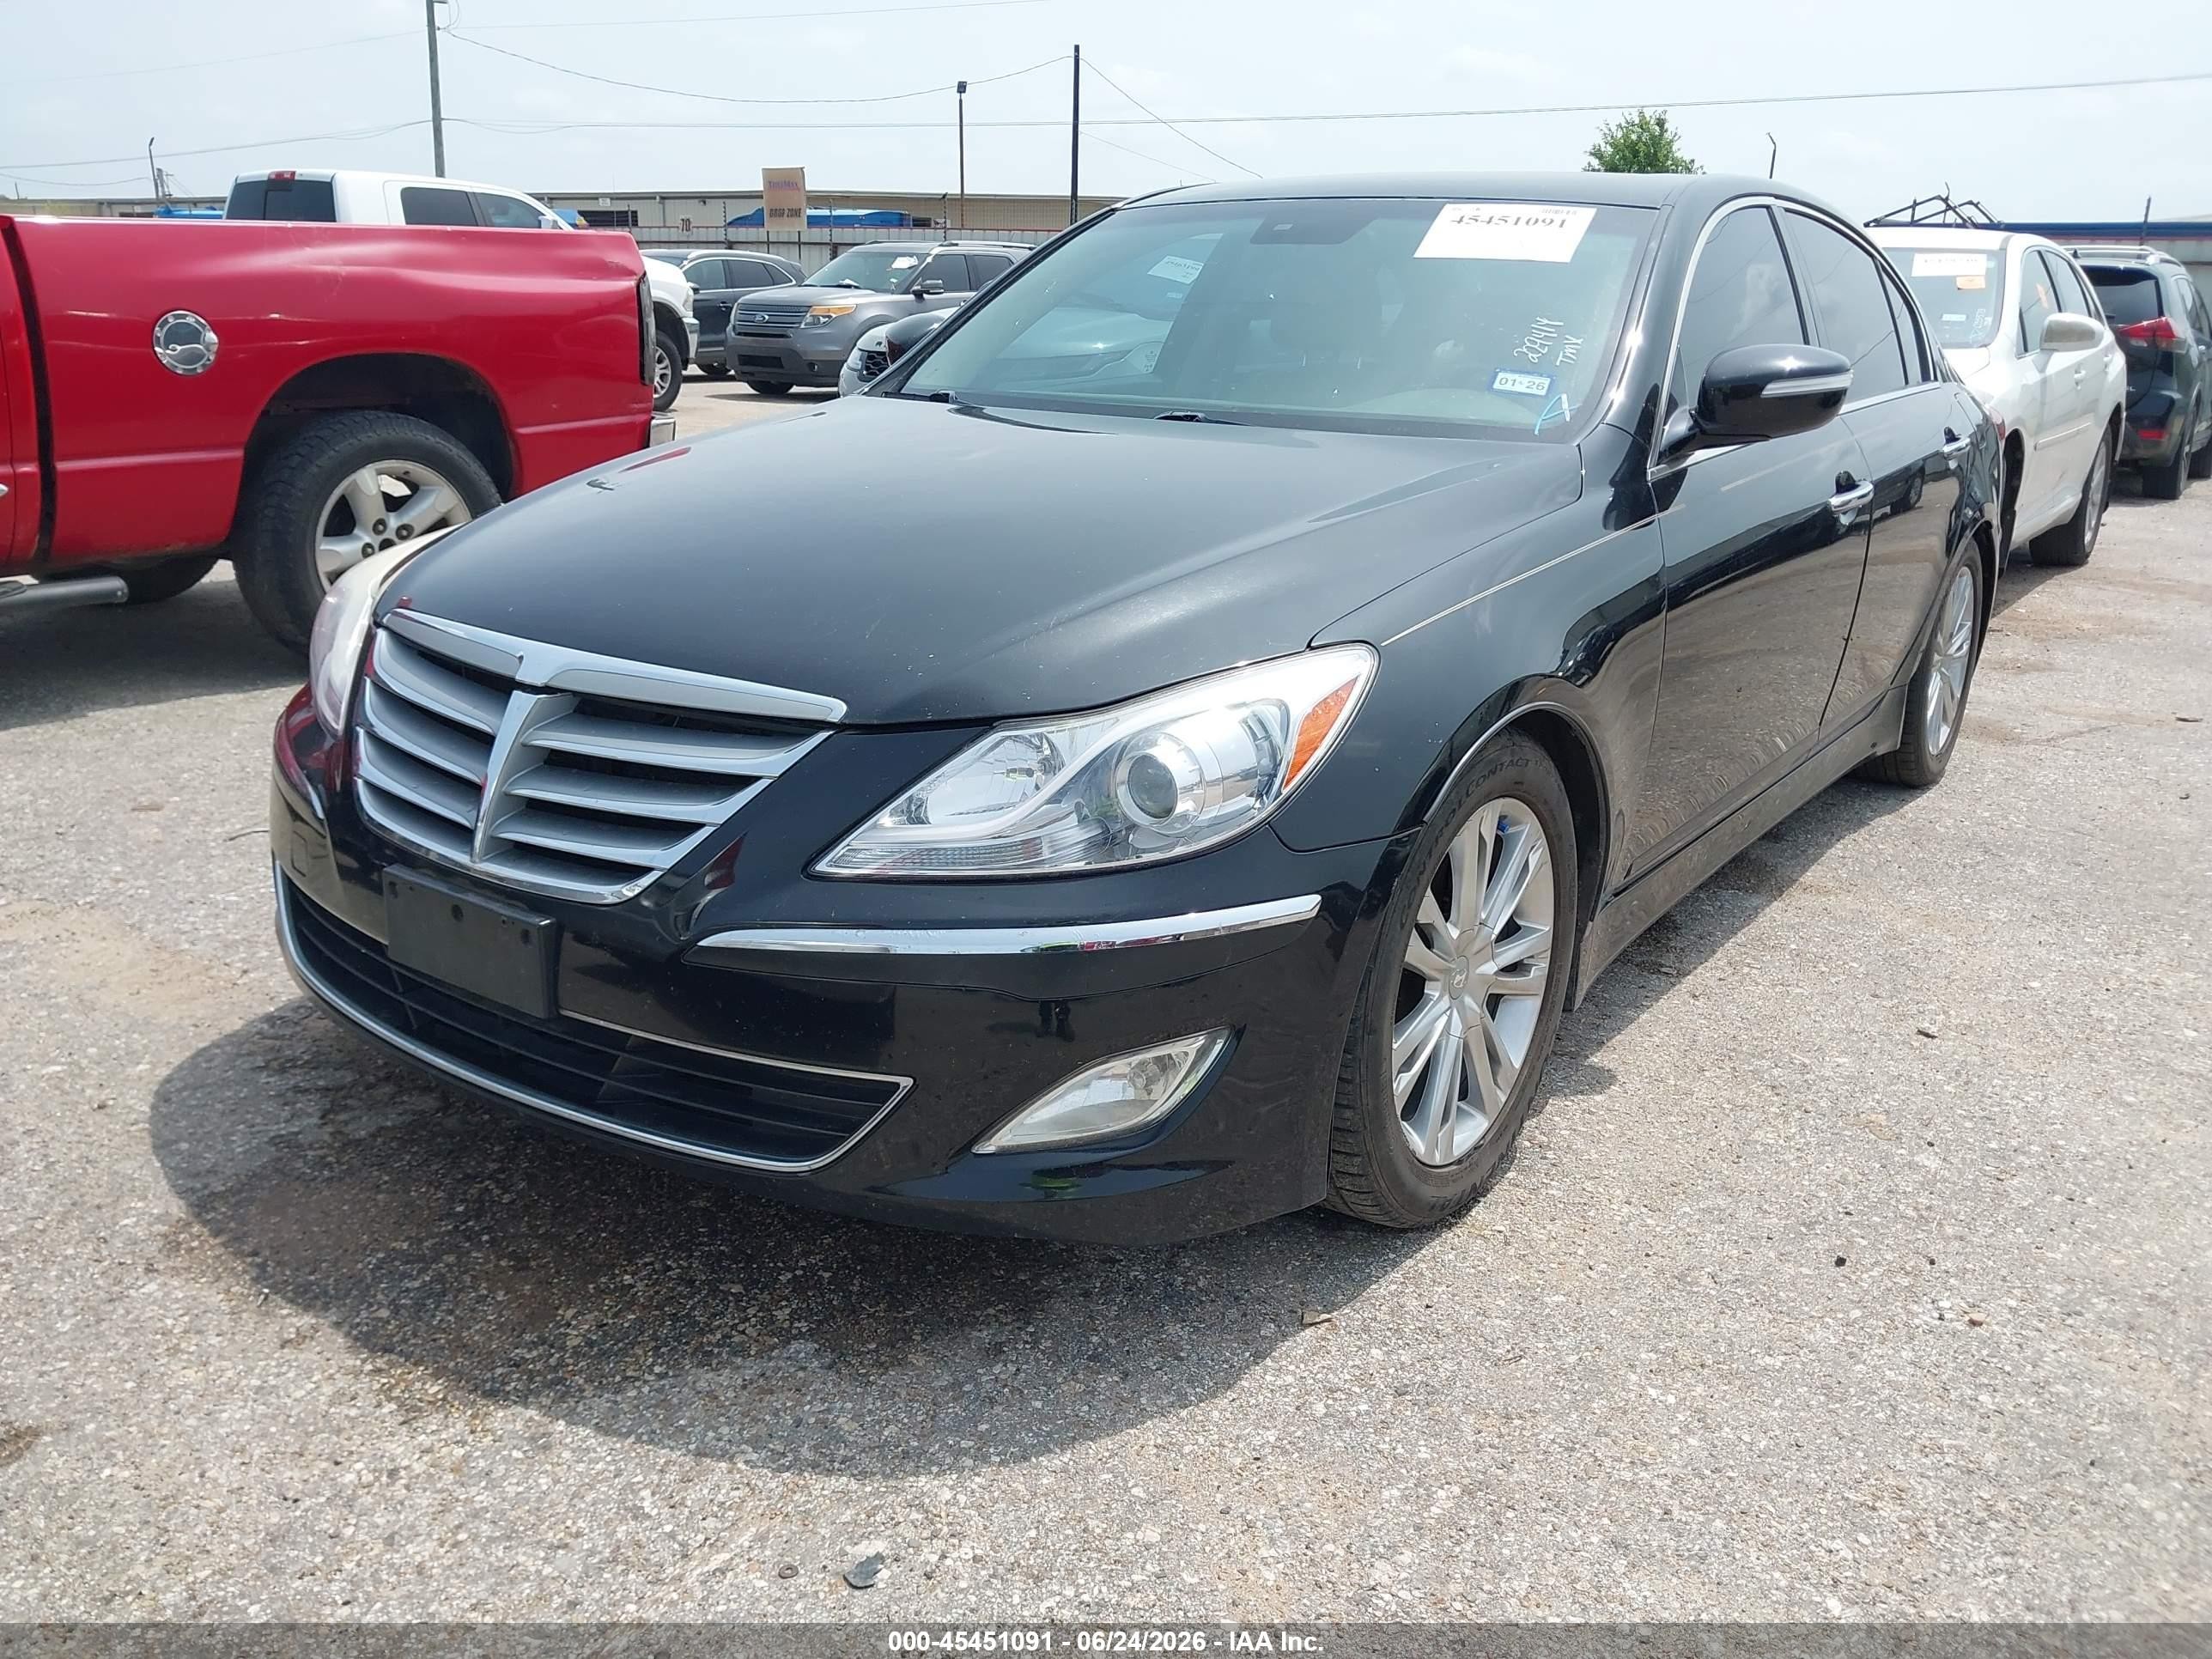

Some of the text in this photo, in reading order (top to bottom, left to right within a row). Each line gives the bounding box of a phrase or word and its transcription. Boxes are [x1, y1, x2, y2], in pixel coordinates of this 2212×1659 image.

[787, 208, 802, 218] ZONE
[680, 218, 691, 232] 70
[1450, 214, 1567, 228] 45451091
